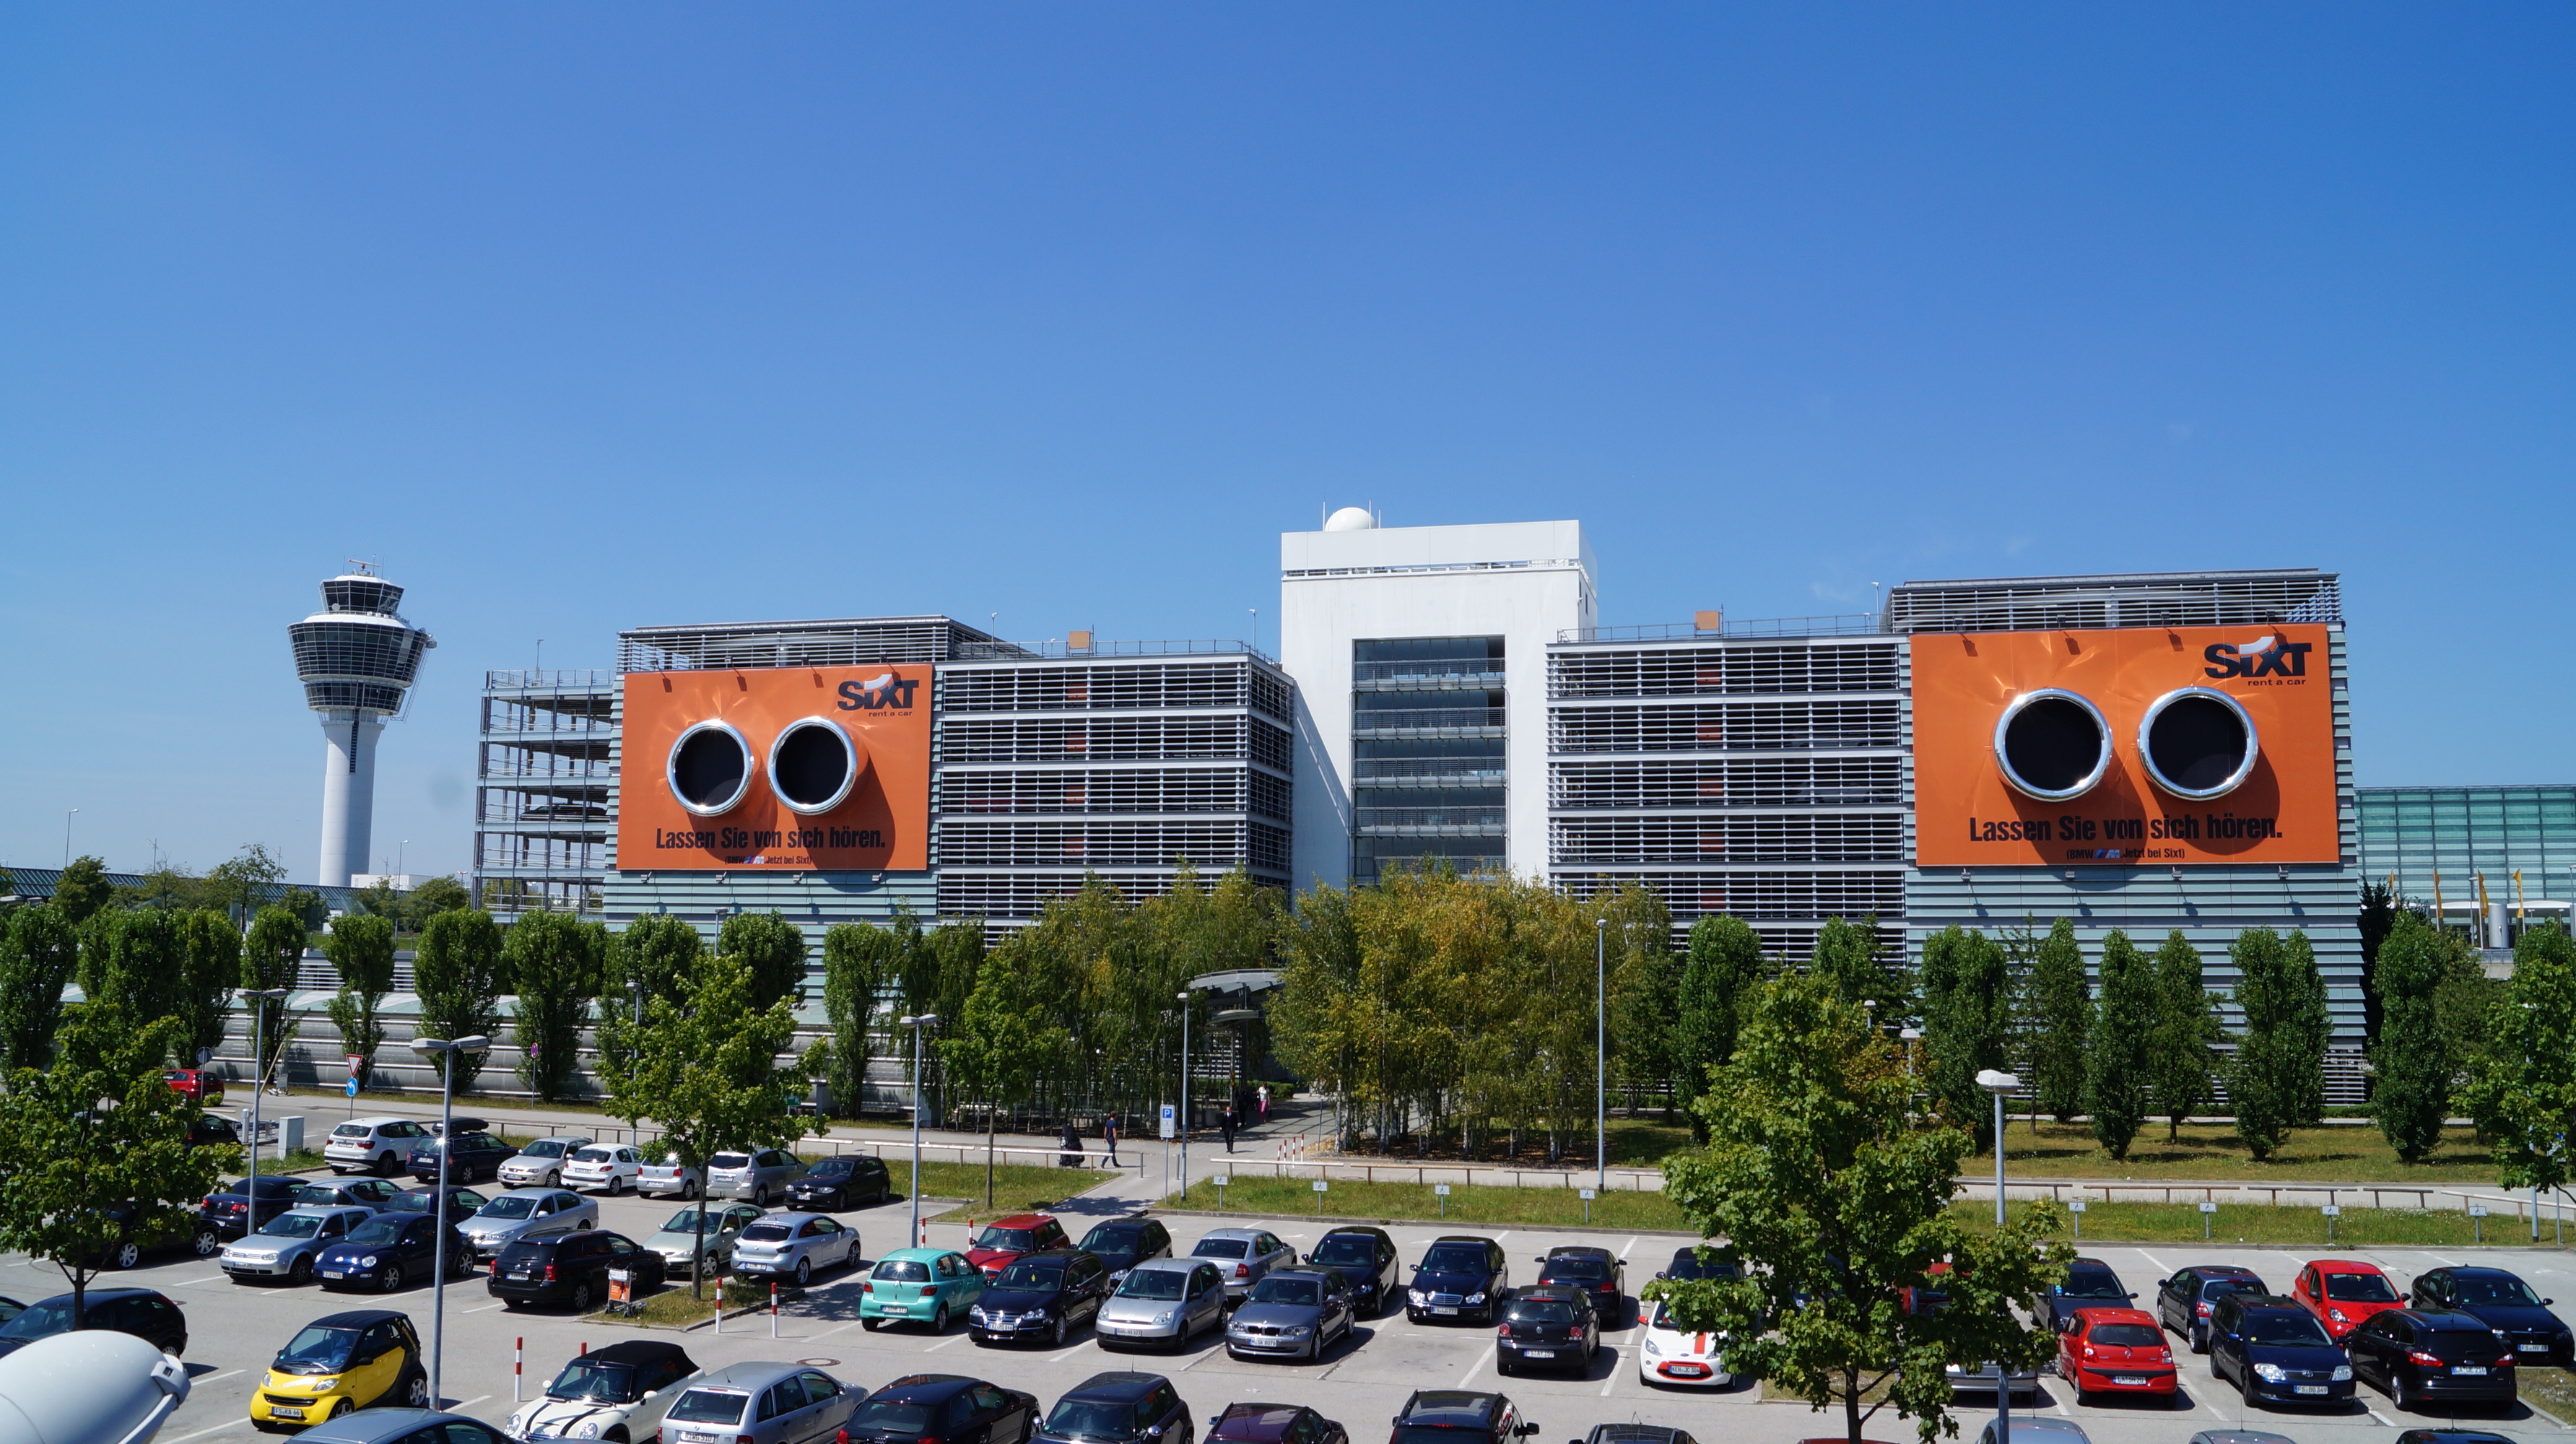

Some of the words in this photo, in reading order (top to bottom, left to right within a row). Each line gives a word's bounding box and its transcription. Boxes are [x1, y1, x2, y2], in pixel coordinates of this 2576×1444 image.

[1970, 817, 2052, 842] Lassen
[2058, 815, 2096, 841] Sie
[2103, 819, 2143, 840] von
[2150, 814, 2199, 840] sich
[2207, 813, 2283, 839] hören.
[656, 828, 715, 849] Lassen
[721, 827, 748, 848] Sie
[754, 830, 782, 848] von
[787, 827, 824, 848] sich
[829, 826, 885, 848] hören.
[784, 856, 794, 864] bei
[2147, 848, 2161, 858] bei
